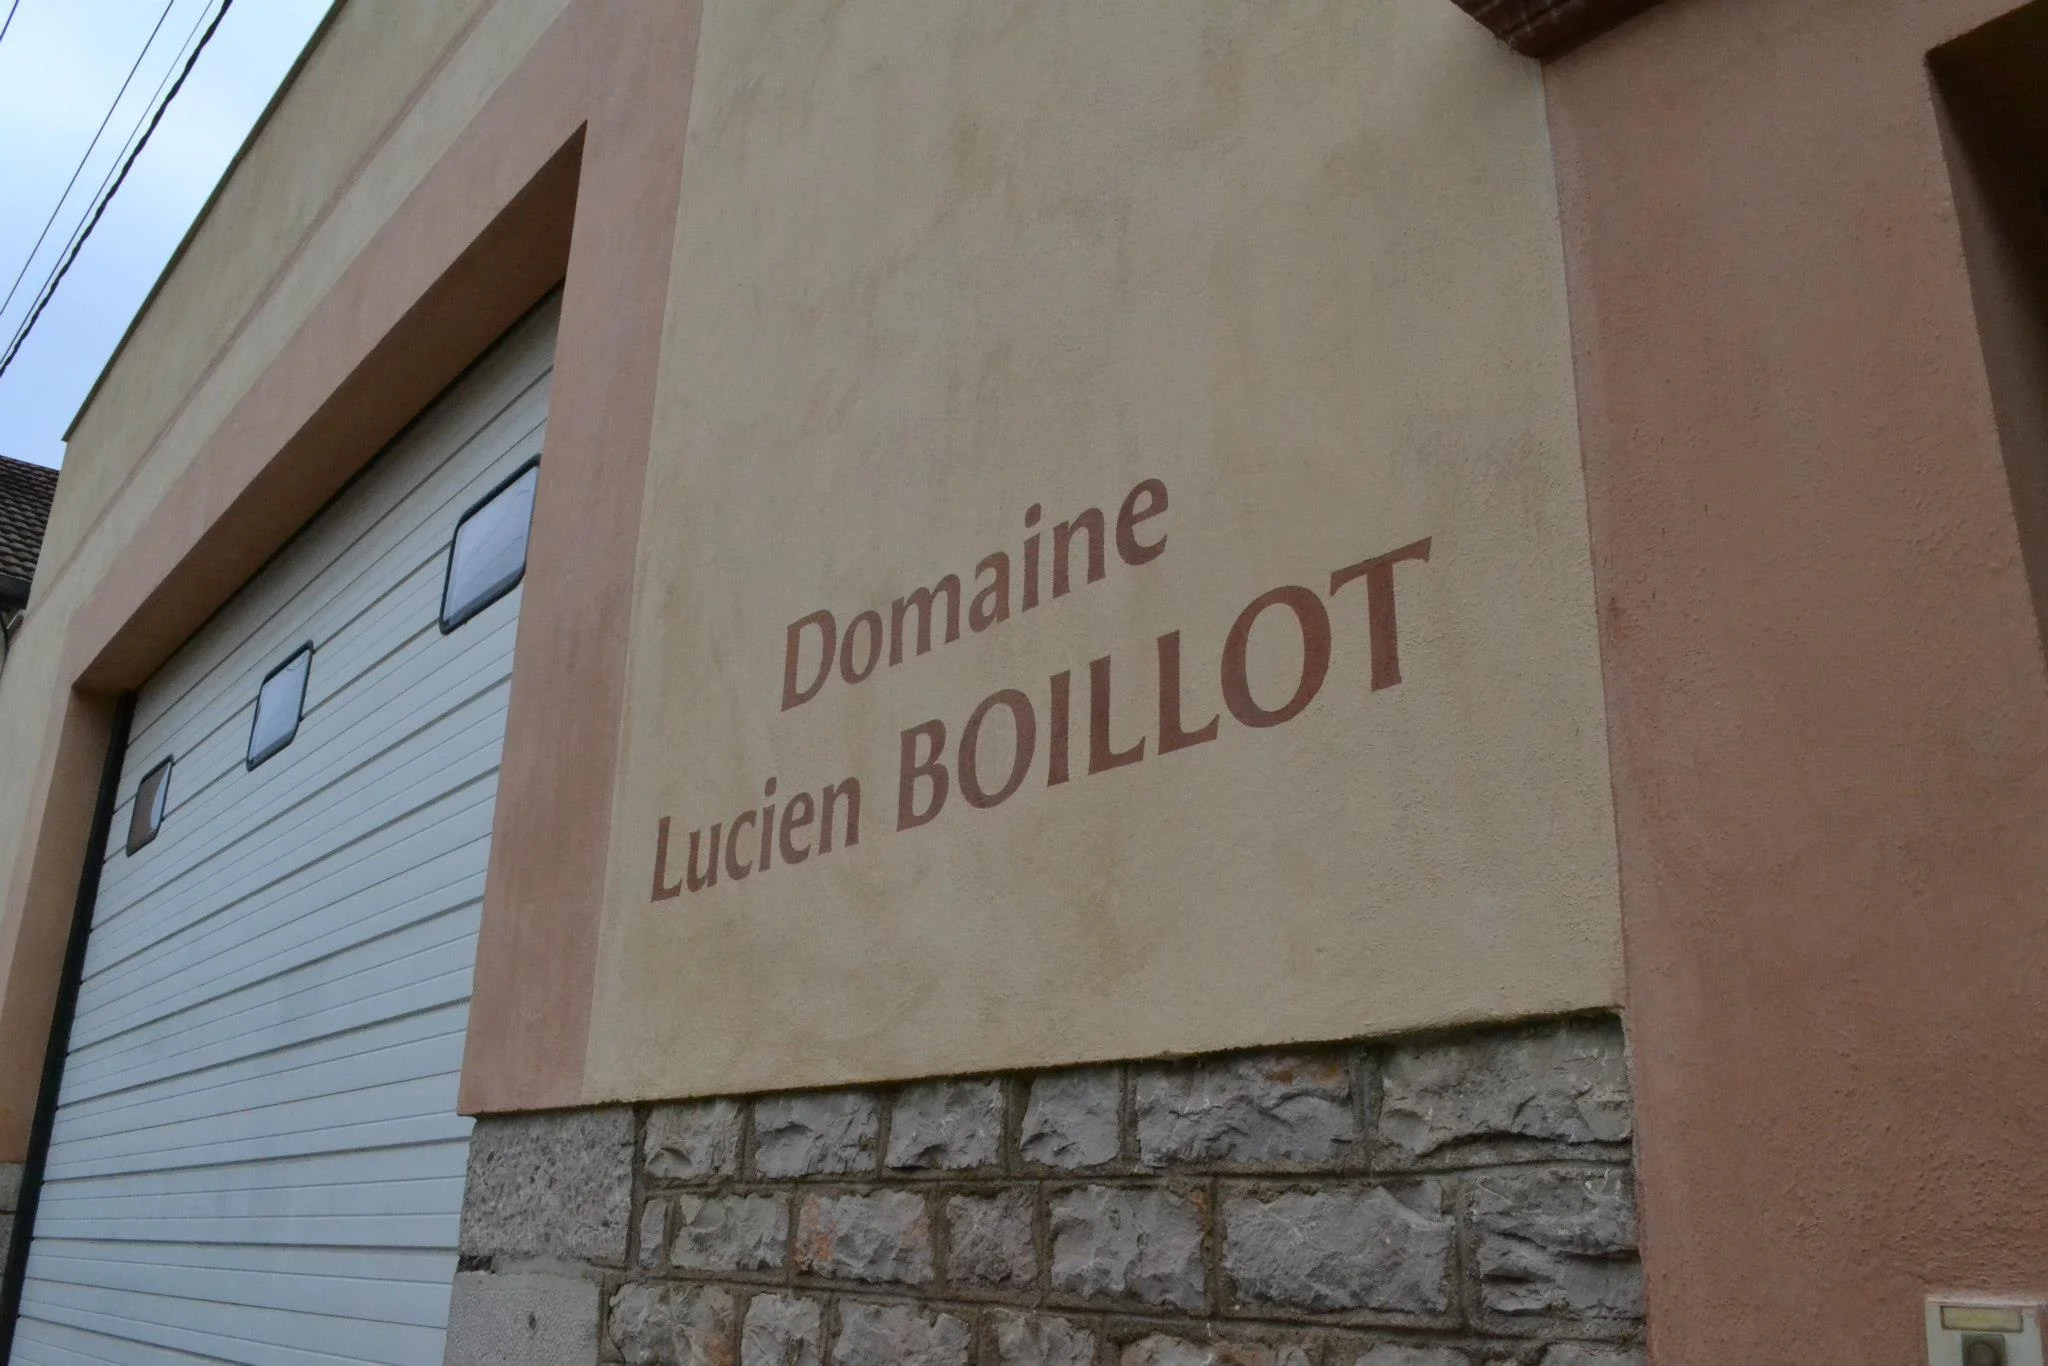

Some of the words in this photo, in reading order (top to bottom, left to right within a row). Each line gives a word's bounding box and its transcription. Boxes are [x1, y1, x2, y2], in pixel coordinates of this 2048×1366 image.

[650, 776, 861, 904] Lucien
[895, 535, 1433, 833] BOILLOT
[780, 478, 1169, 712] Domaine
